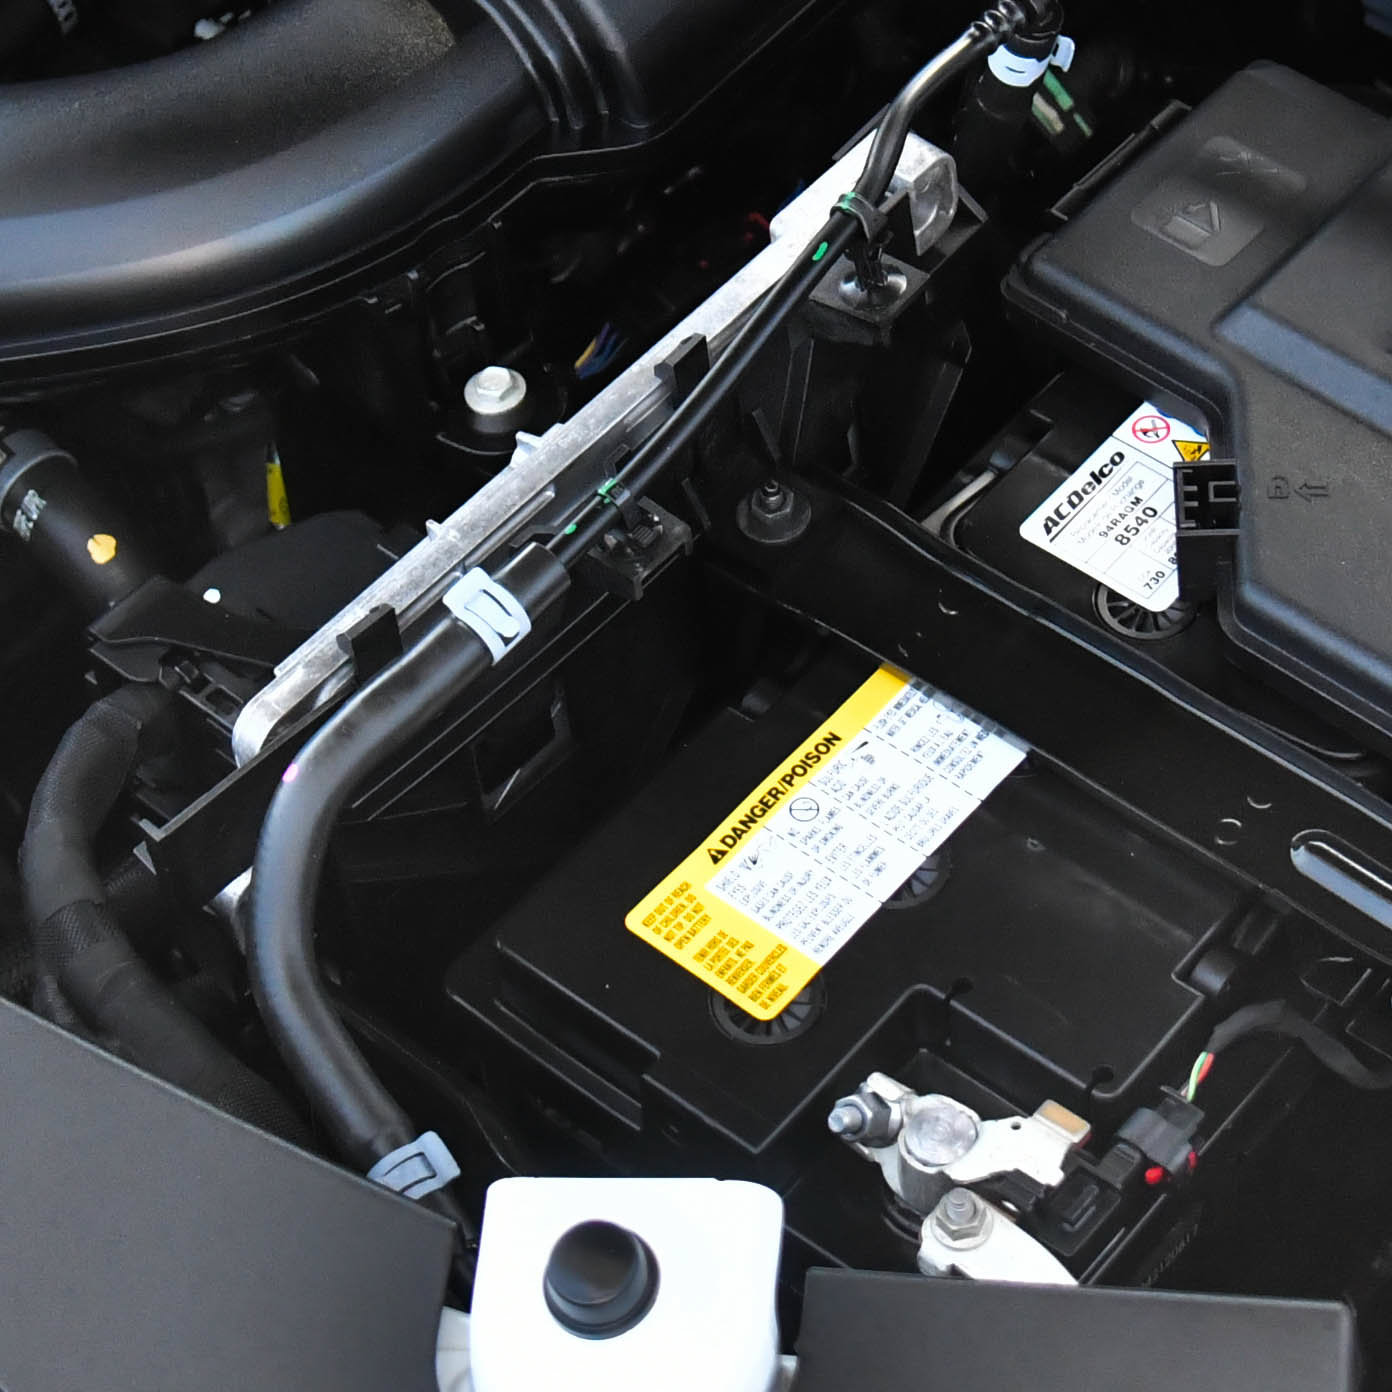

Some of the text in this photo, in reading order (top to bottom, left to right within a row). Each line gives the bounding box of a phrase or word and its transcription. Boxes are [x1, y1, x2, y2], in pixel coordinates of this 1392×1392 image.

[1043, 451, 1125, 536] ACDelco
[1114, 506, 1158, 546] 8540
[1144, 571, 1165, 590] 730
[721, 730, 843, 850] DANGER/POISON
